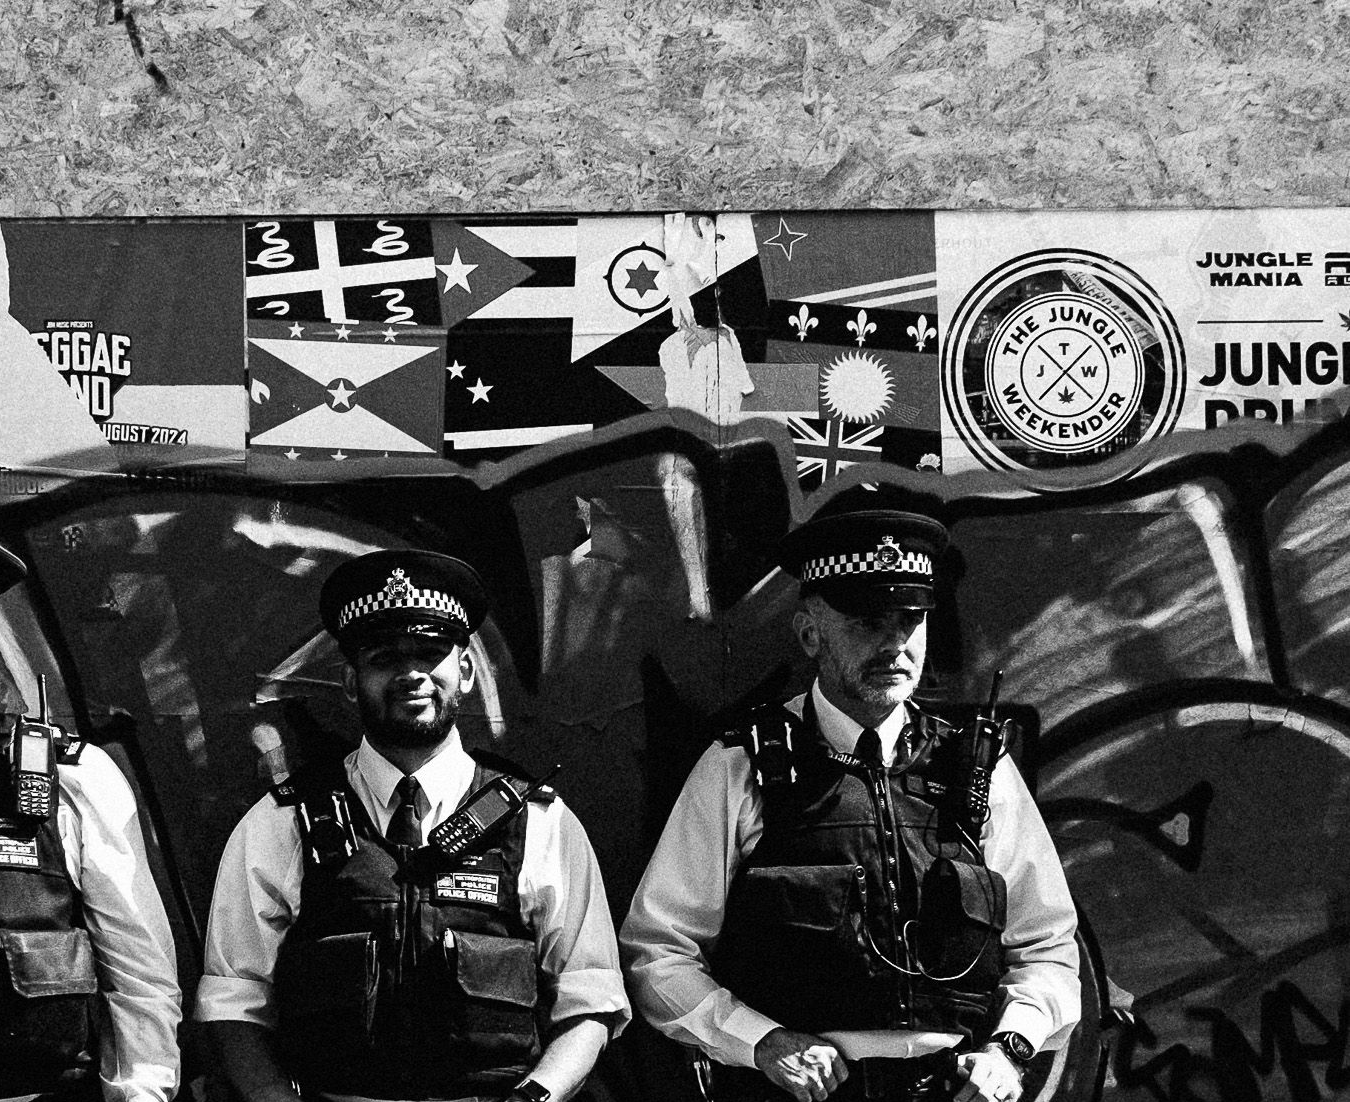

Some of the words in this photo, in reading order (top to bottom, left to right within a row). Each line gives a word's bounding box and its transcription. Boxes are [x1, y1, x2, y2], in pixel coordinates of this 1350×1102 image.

[1196, 252, 1313, 268] JUNGLE
[1210, 272, 1303, 287] MANIA
[1002, 316, 1040, 356] THE
[1049, 306, 1127, 358] JUNGLE
[1059, 343, 1070, 355] T
[1036, 365, 1045, 377] J
[1081, 366, 1098, 377] W
[1002, 383, 1126, 438] WEEKENDER
[151, 426, 187, 445] 2024
[10, 855, 38, 866] OFFICER
[460, 882, 492, 890] POLICE
[437, 889, 466, 898] POLICE
[468, 891, 498, 903] OFFICER
